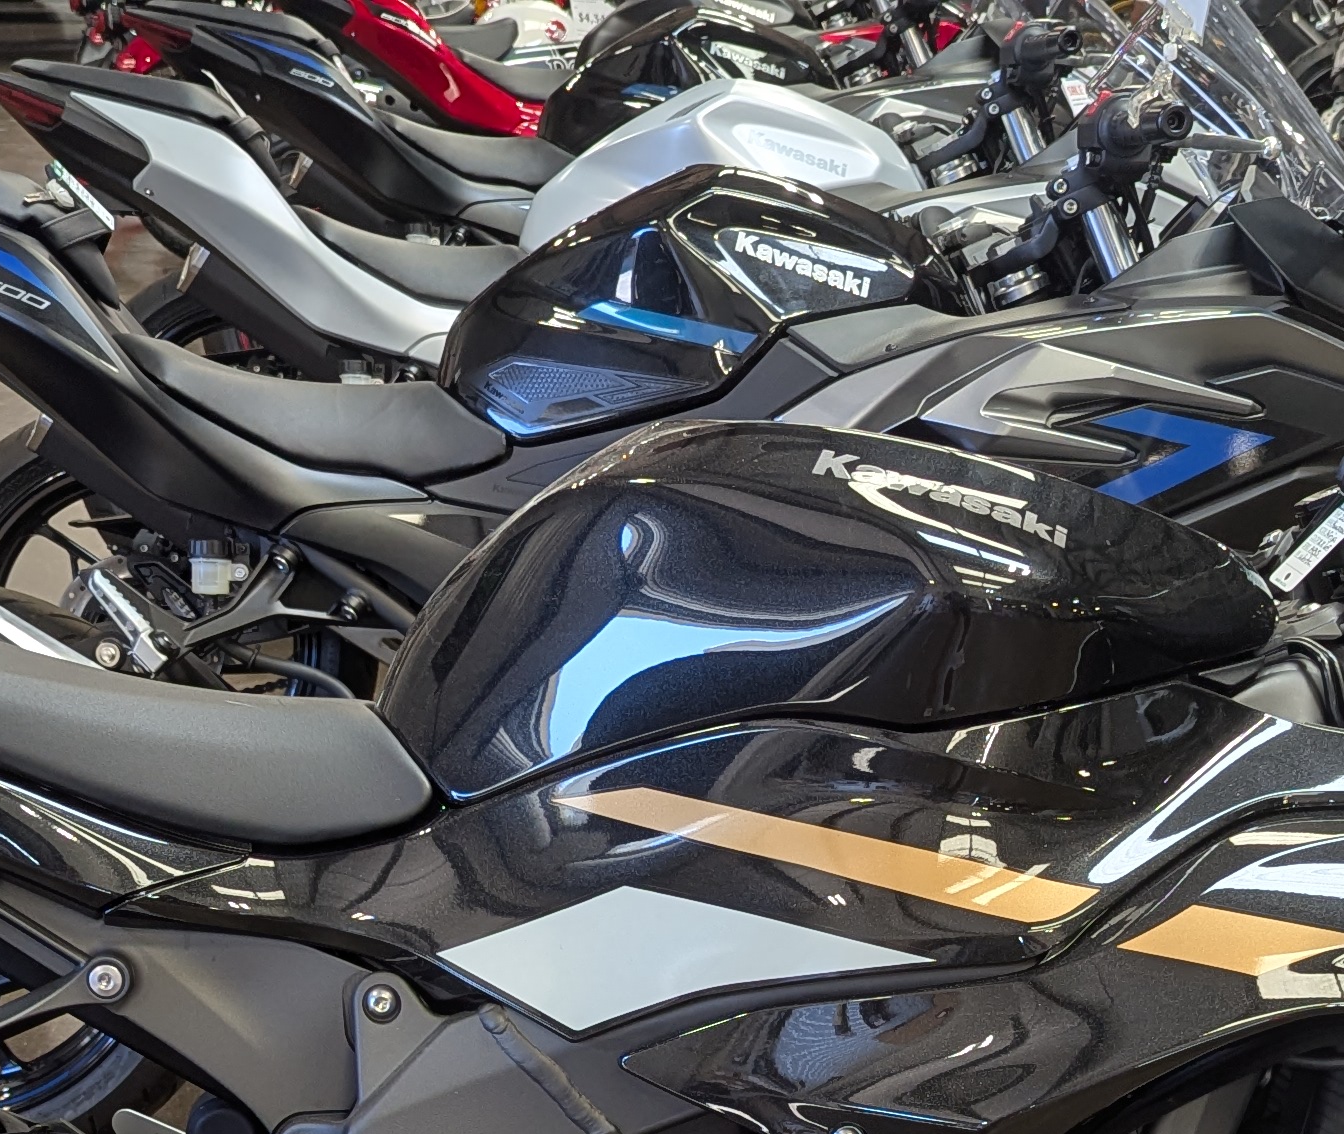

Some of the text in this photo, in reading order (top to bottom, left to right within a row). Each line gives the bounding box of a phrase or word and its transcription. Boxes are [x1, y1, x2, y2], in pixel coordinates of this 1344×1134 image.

[710, 42, 787, 80] Kawasaki
[747, 128, 849, 178] Kawasaki
[734, 230, 871, 299] Kawasaki
[811, 449, 1068, 549] Kawasaki
